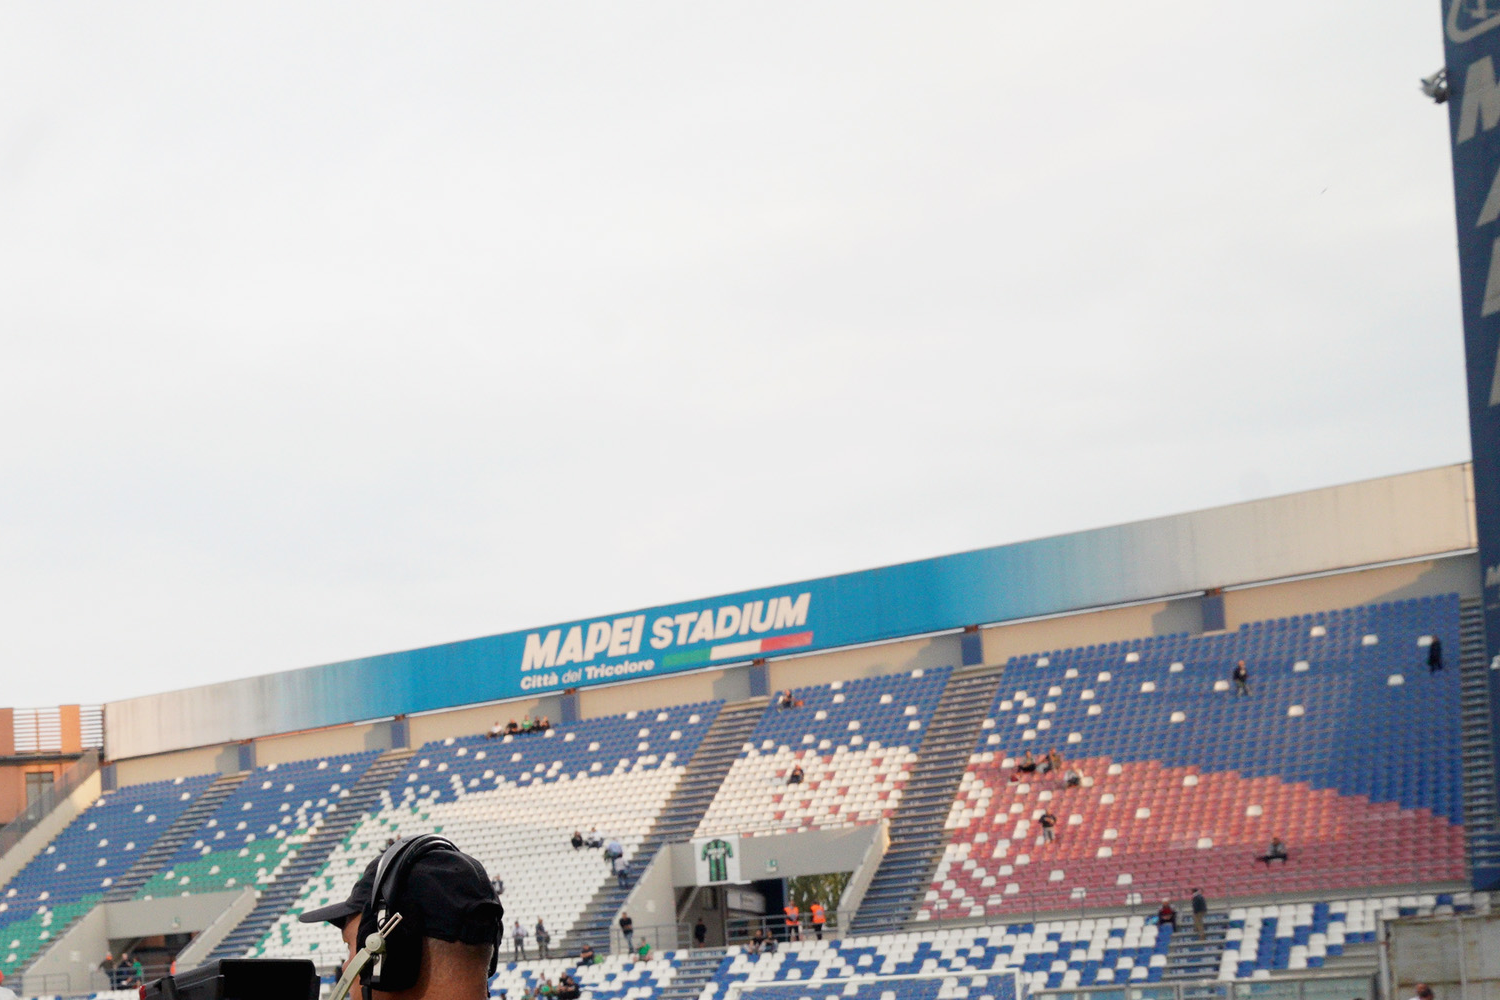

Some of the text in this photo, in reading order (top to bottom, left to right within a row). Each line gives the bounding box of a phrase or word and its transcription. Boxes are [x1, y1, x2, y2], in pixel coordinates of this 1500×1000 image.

[520, 592, 812, 672] MAPEI STADIUM
[520, 672, 558, 690] Città
[585, 658, 655, 680] Tricolore
